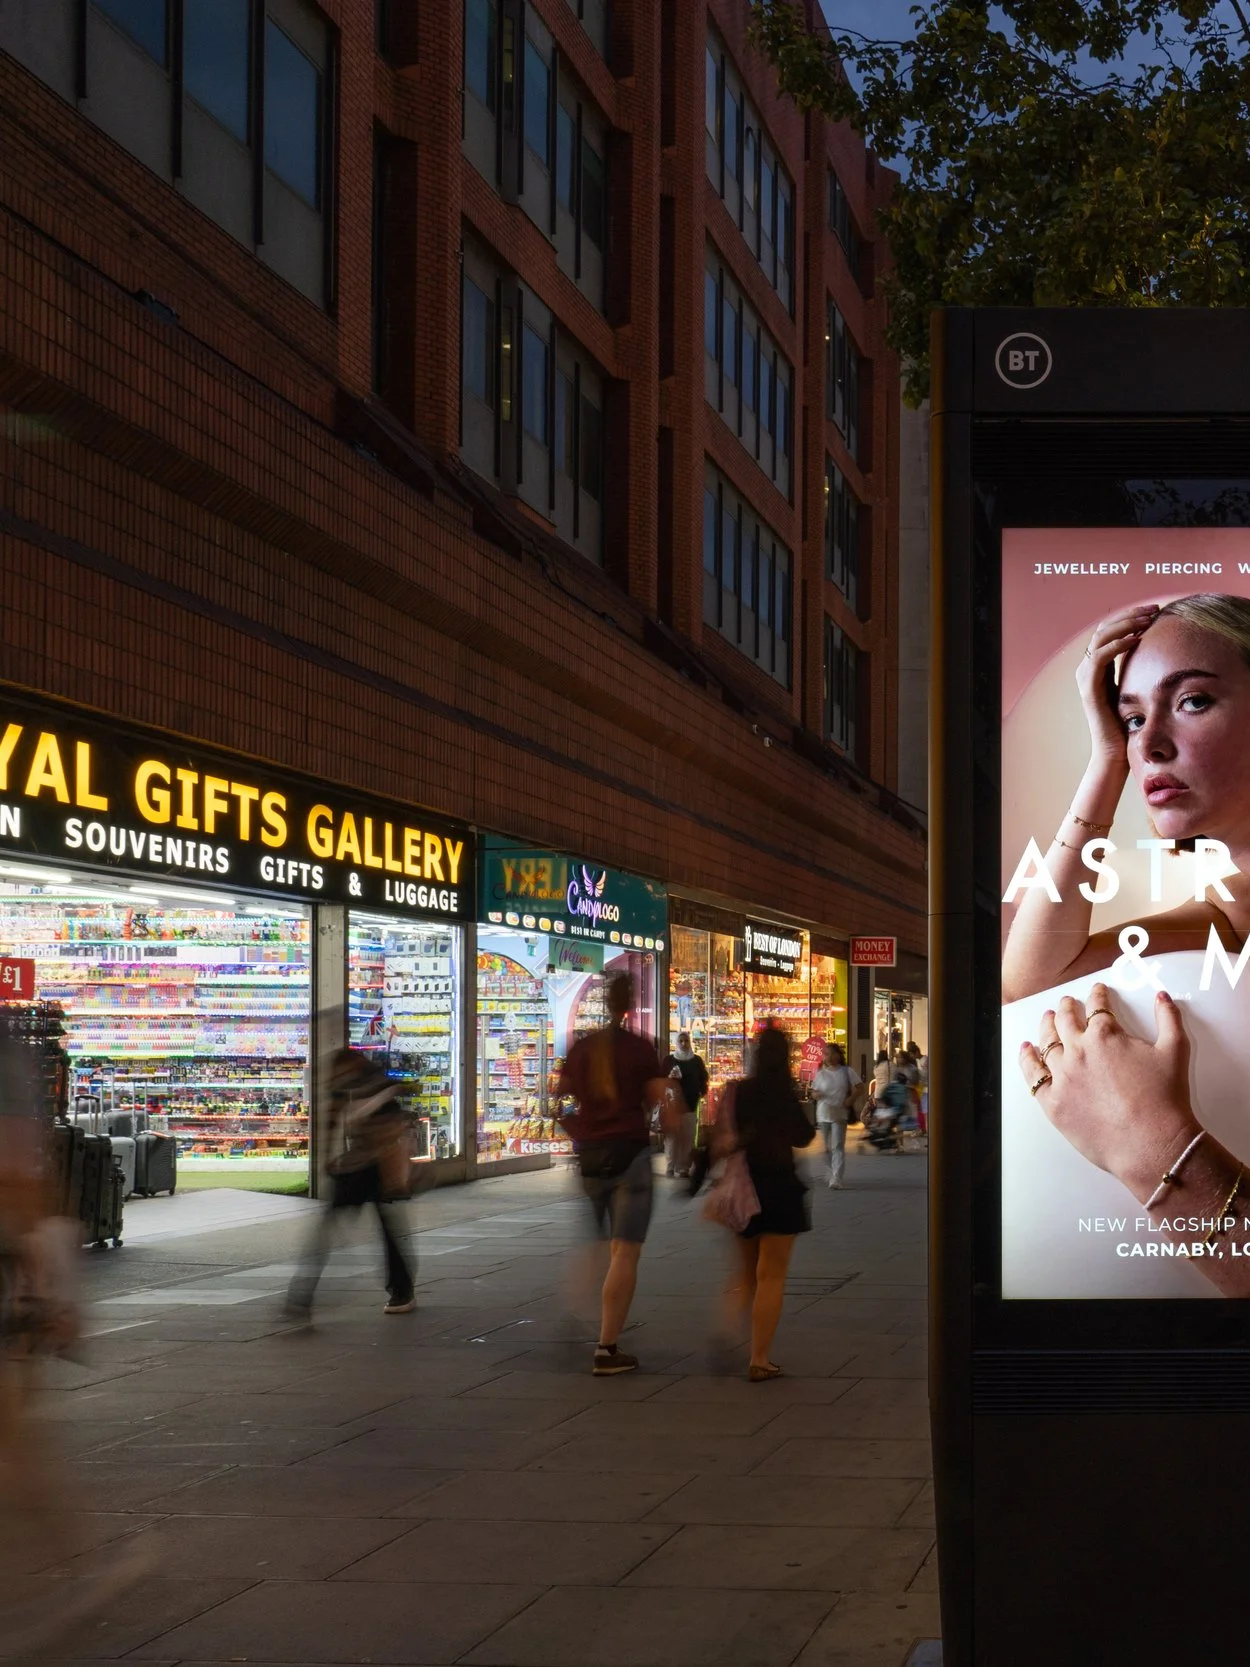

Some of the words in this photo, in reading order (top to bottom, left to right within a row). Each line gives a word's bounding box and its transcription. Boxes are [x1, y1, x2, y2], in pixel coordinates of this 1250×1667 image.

[1008, 350, 1040, 371] BT
[1034, 562, 1130, 575] JEWELLERY
[1145, 562, 1223, 575] PIERCING
[134, 759, 288, 848] GIFTS
[306, 803, 464, 884] GALLERY
[65, 818, 230, 874] SOUVENIRS
[260, 856, 324, 890] GIFTS
[349, 872, 362, 896] &
[385, 878, 458, 913] LUGGAGE
[753, 932, 769, 952] BEST
[769, 935, 778, 953] OF
[777, 937, 802, 958] LONDON
[855, 941, 892, 952] MONEY
[853, 953, 892, 962] EXCHANGE
[1109, 925, 1168, 992] &
[3, 966, 22, 991] £1
[805, 1044, 823, 1056] 70%
[806, 1053, 818, 1061] OFF
[1078, 1217, 1127, 1233] NEW
[1135, 1216, 1236, 1232] FLAGSHIP
[1116, 1242, 1224, 1260] CARNABY,
